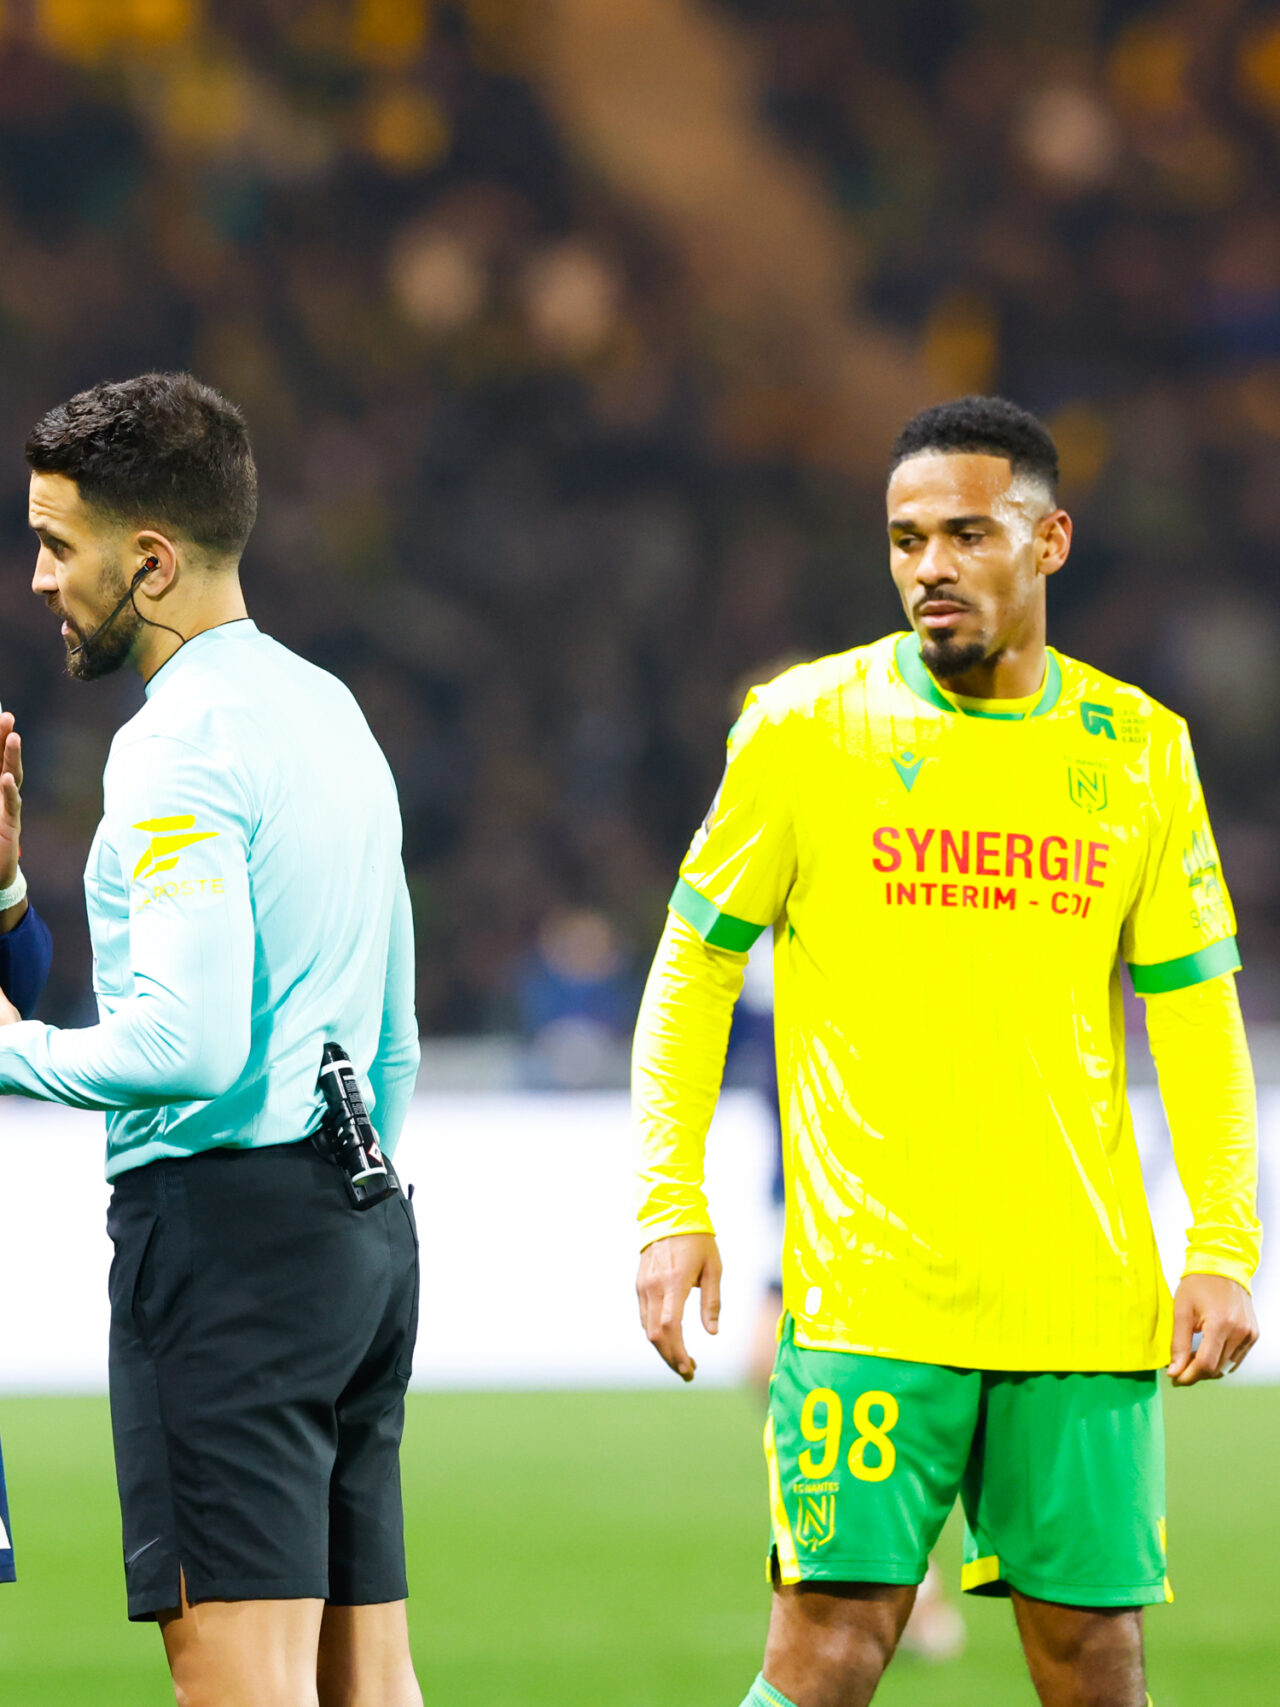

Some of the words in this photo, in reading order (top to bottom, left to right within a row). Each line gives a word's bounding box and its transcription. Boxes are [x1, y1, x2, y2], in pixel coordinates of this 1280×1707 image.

[872, 826, 1110, 888] SYNERGIE
[886, 882, 1017, 910] INTERIM
[798, 1387, 899, 1482] 98
